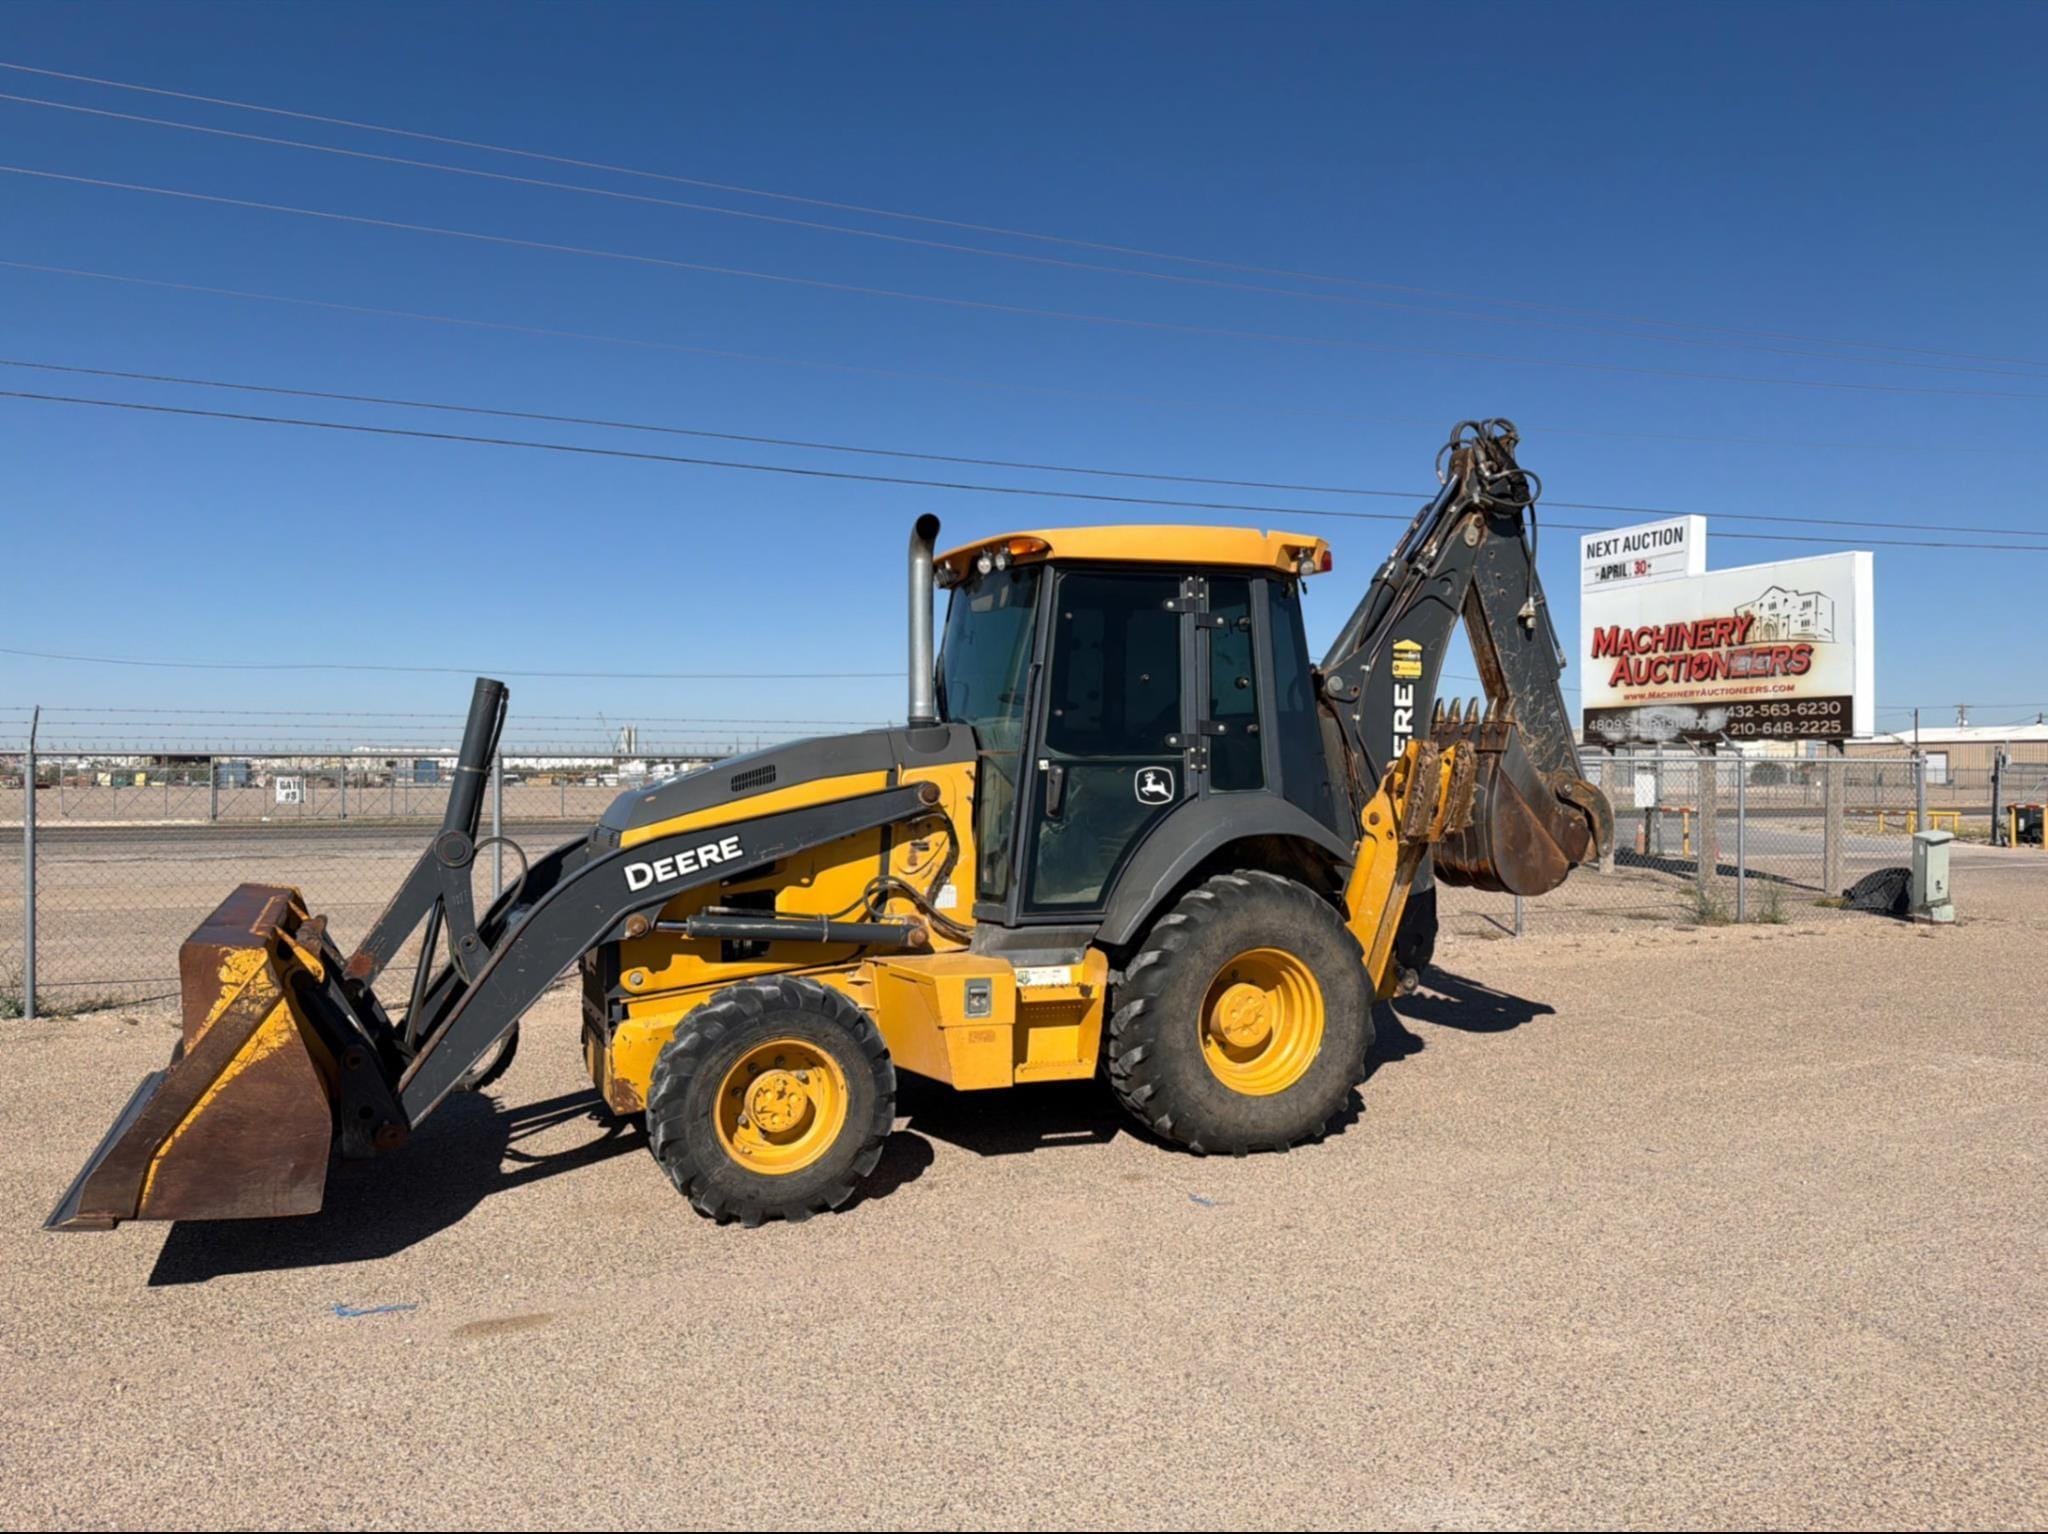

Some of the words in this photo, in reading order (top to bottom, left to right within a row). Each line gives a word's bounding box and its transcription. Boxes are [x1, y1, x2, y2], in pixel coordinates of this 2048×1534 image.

[1587, 538, 1620, 559] NEXT
[1622, 526, 1684, 553] AUCTION
[1591, 616, 1754, 660] MACHINERY
[1393, 683, 1414, 759] ERE
[1588, 718, 1622, 731] 4809
[1727, 701, 1842, 719] 432-563-6230
[1730, 719, 1842, 736] 210-648-2225
[624, 835, 743, 892] DEERE
